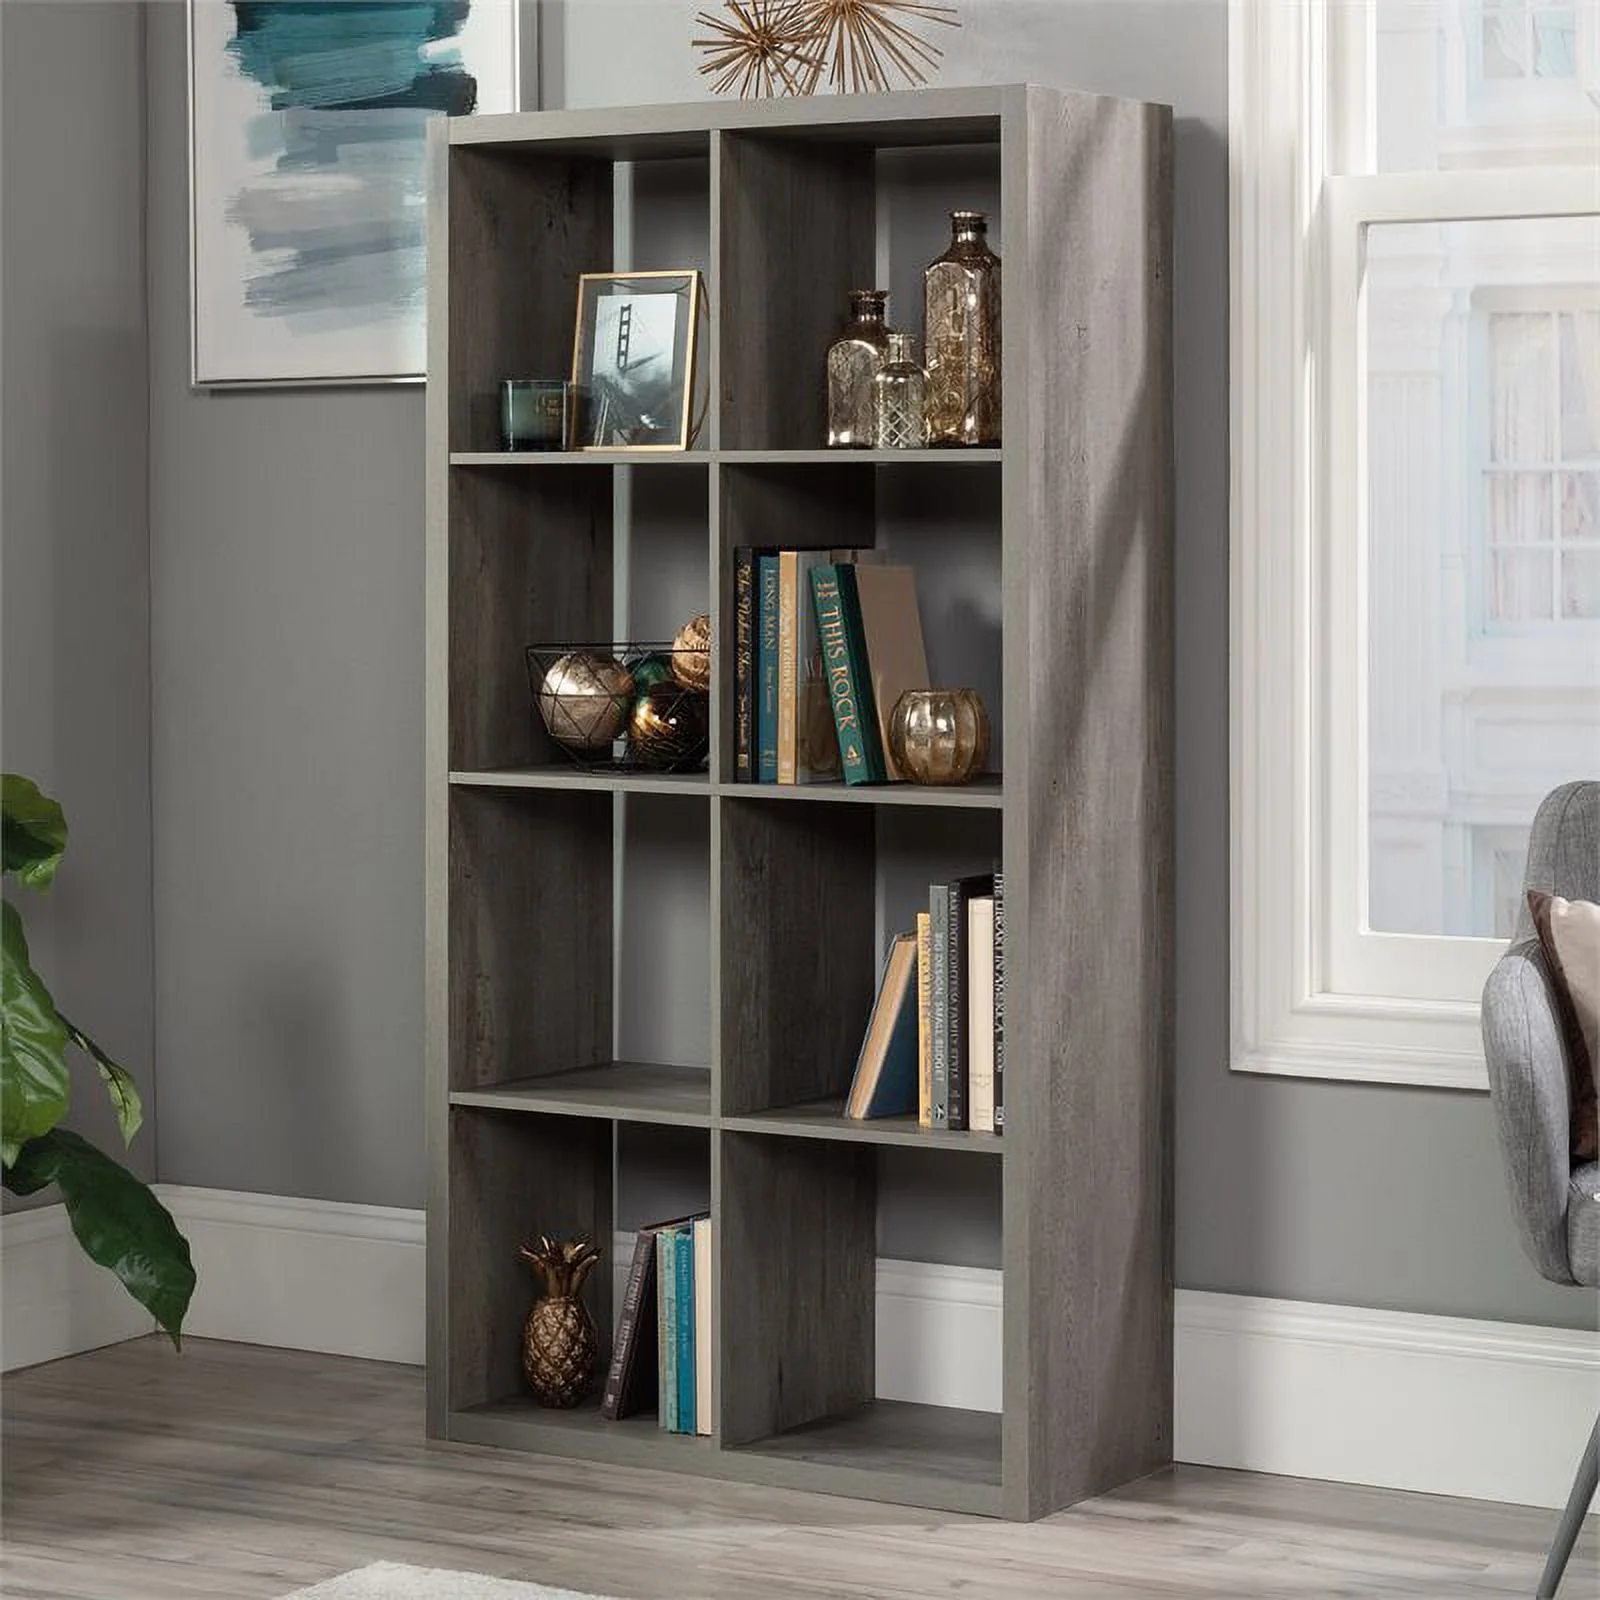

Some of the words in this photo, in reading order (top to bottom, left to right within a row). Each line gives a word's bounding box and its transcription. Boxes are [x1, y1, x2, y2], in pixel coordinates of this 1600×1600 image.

[764, 568, 776, 610] LONG
[764, 615, 776, 650] MAN
[820, 606, 845, 659] THIS
[831, 666, 857, 733] ROCK
[994, 872, 1004, 897] THE
[994, 900, 1004, 951] LIBRARY
[934, 1000, 945, 1036] SMALL
[994, 974, 1004, 1033] AMERICA
[934, 1039, 945, 1082] BUDGET
